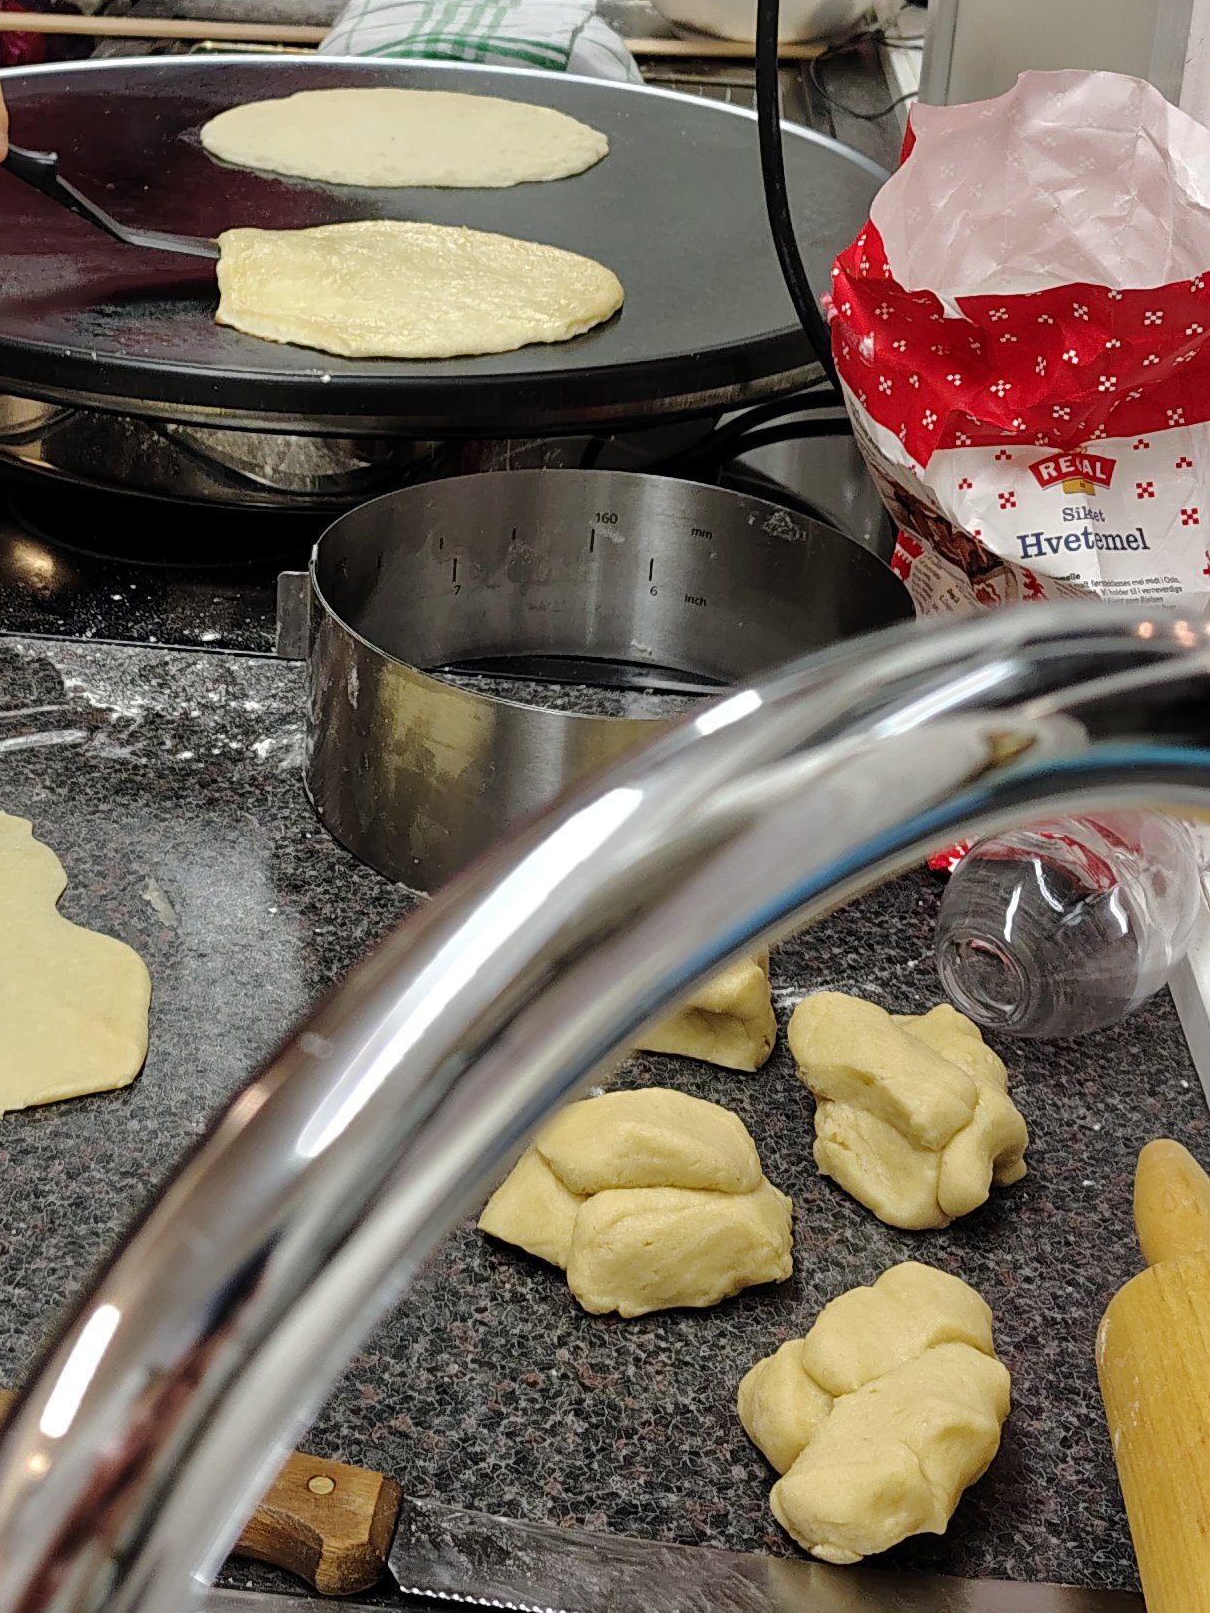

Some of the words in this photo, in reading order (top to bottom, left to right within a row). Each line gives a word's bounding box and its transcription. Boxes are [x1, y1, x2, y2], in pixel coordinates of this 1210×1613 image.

[595, 512, 619, 525] 160
[1061, 505, 1106, 523] Siket
[691, 528, 713, 540] mm
[1016, 525, 1151, 560] Hvetemel
[453, 584, 462, 596] 7
[649, 585, 658, 597] 6
[684, 593, 707, 608] inch
